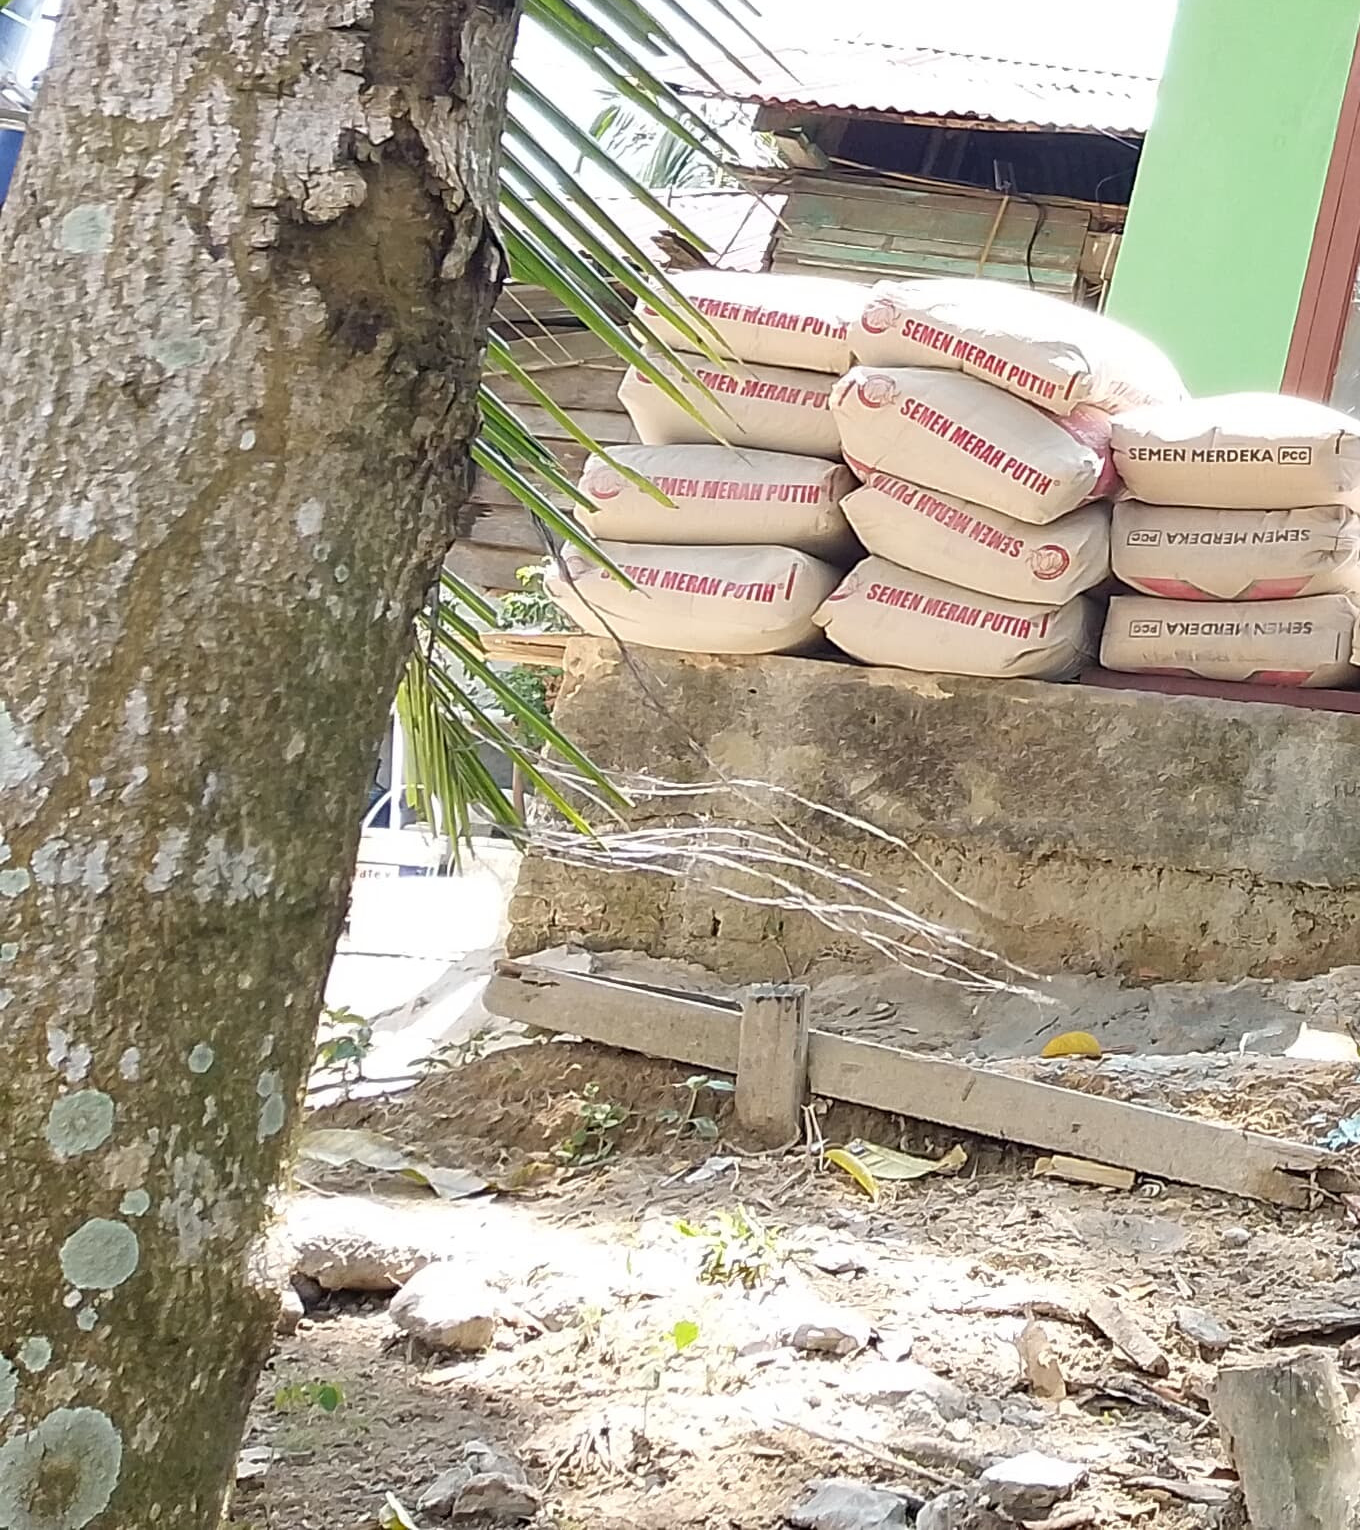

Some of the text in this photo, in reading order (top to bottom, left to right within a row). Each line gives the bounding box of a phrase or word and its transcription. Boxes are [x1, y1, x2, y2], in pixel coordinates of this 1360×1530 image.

[902, 319, 954, 353] SEMEN
[952, 340, 1007, 372] MERAH
[684, 370, 739, 394] EMEN
[740, 380, 801, 404] MERAH
[900, 398, 953, 438] SEMEN
[950, 425, 1004, 469] MERAH
[1129, 447, 1309, 464] SEMEN MERDEKA PCC
[643, 476, 698, 499] EMEN
[701, 480, 762, 501] MERAH
[915, 493, 973, 534] MERAH
[969, 521, 1024, 558] SEMEN
[1132, 528, 1311, 545] SEMEN MERDEKA PCC
[660, 572, 721, 596] MERAH
[867, 583, 923, 611] SEMEN
[921, 598, 981, 626] MERAH
[1133, 625, 1158, 634] PCC
[1253, 621, 1313, 635] SEMEN
